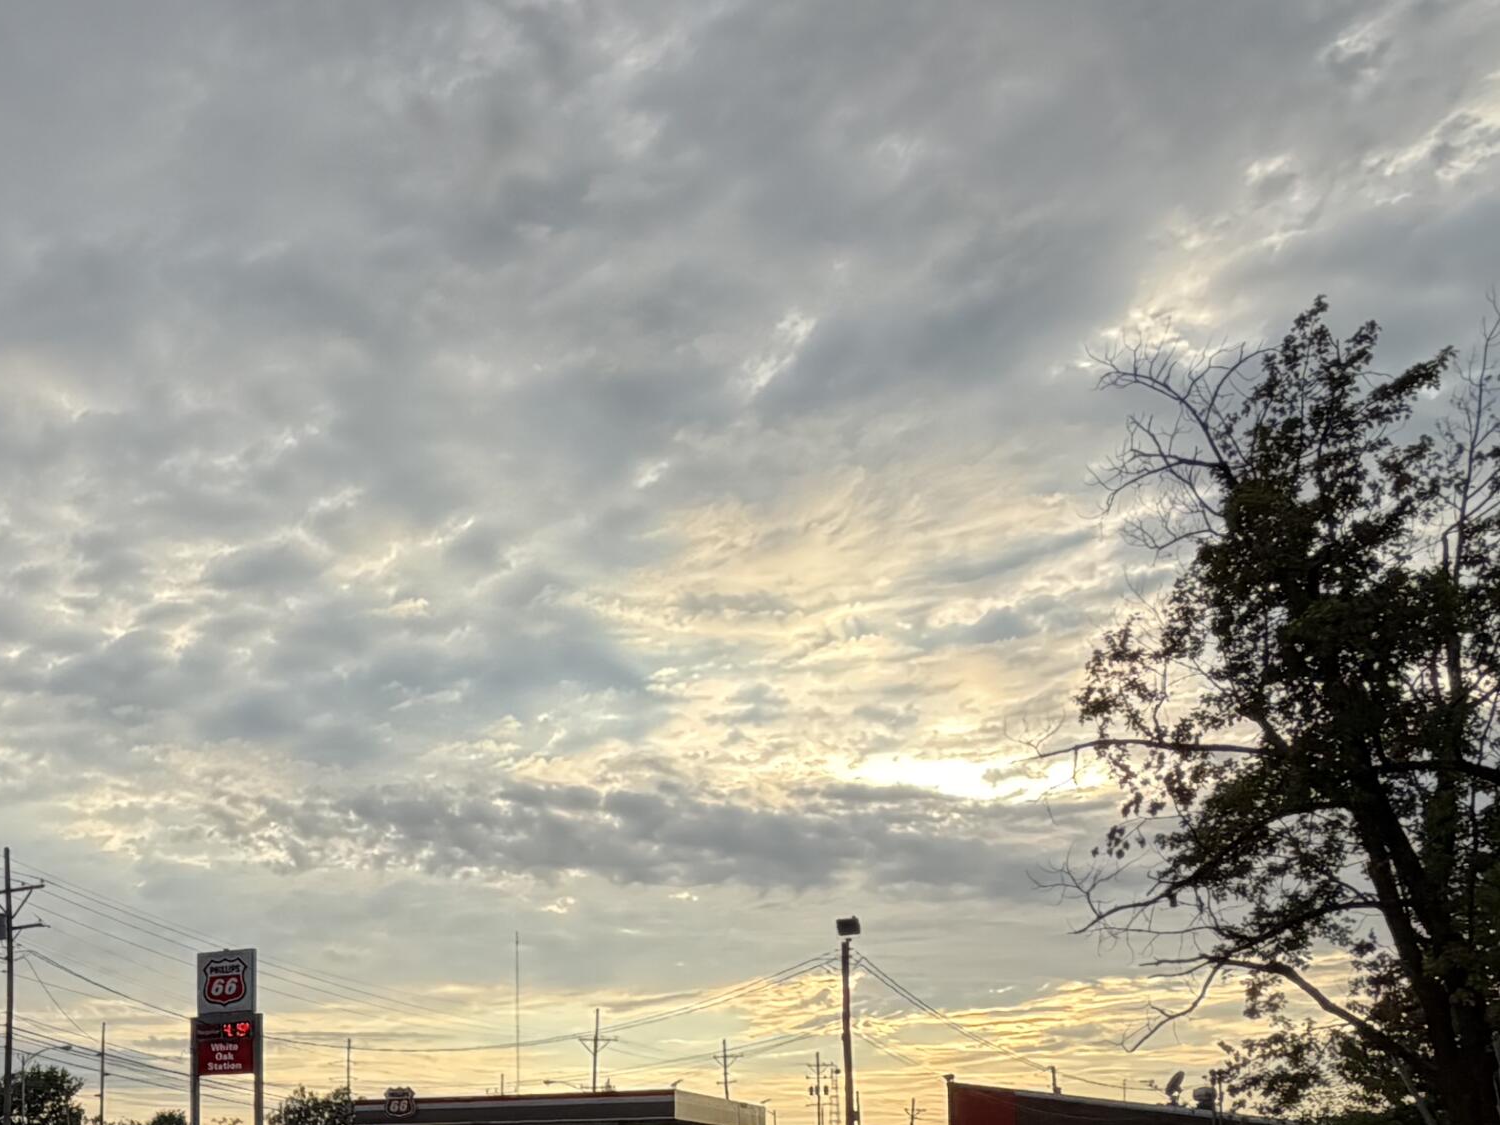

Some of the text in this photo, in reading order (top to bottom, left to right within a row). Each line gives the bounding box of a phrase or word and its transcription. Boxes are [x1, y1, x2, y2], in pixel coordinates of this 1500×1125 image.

[209, 964, 241, 975] PHILLIPS
[211, 977, 238, 996] 66
[210, 1042, 239, 1052] White
[215, 1052, 235, 1061] Oak
[207, 1062, 243, 1071] Station
[389, 1099, 408, 1113] 66
